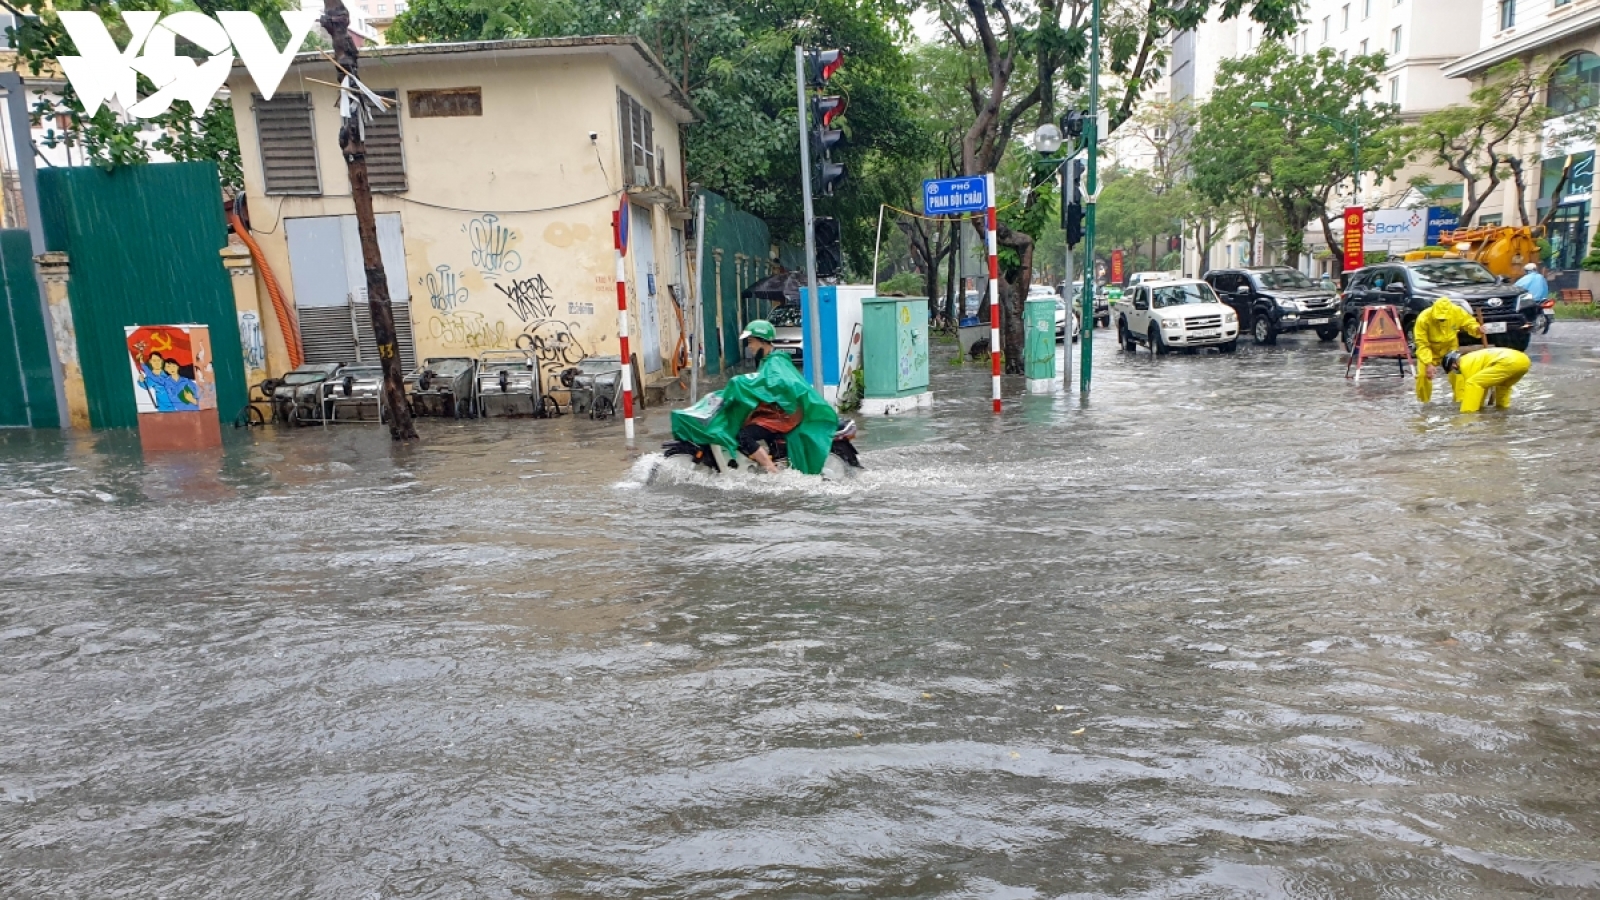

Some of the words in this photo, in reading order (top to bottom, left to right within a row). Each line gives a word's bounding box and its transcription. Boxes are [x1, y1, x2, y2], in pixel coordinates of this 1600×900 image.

[951, 181, 970, 191] PHỐ
[929, 194, 949, 208] PHAN
[950, 191, 962, 208] BỘI
[963, 190, 982, 206] CHÂU
